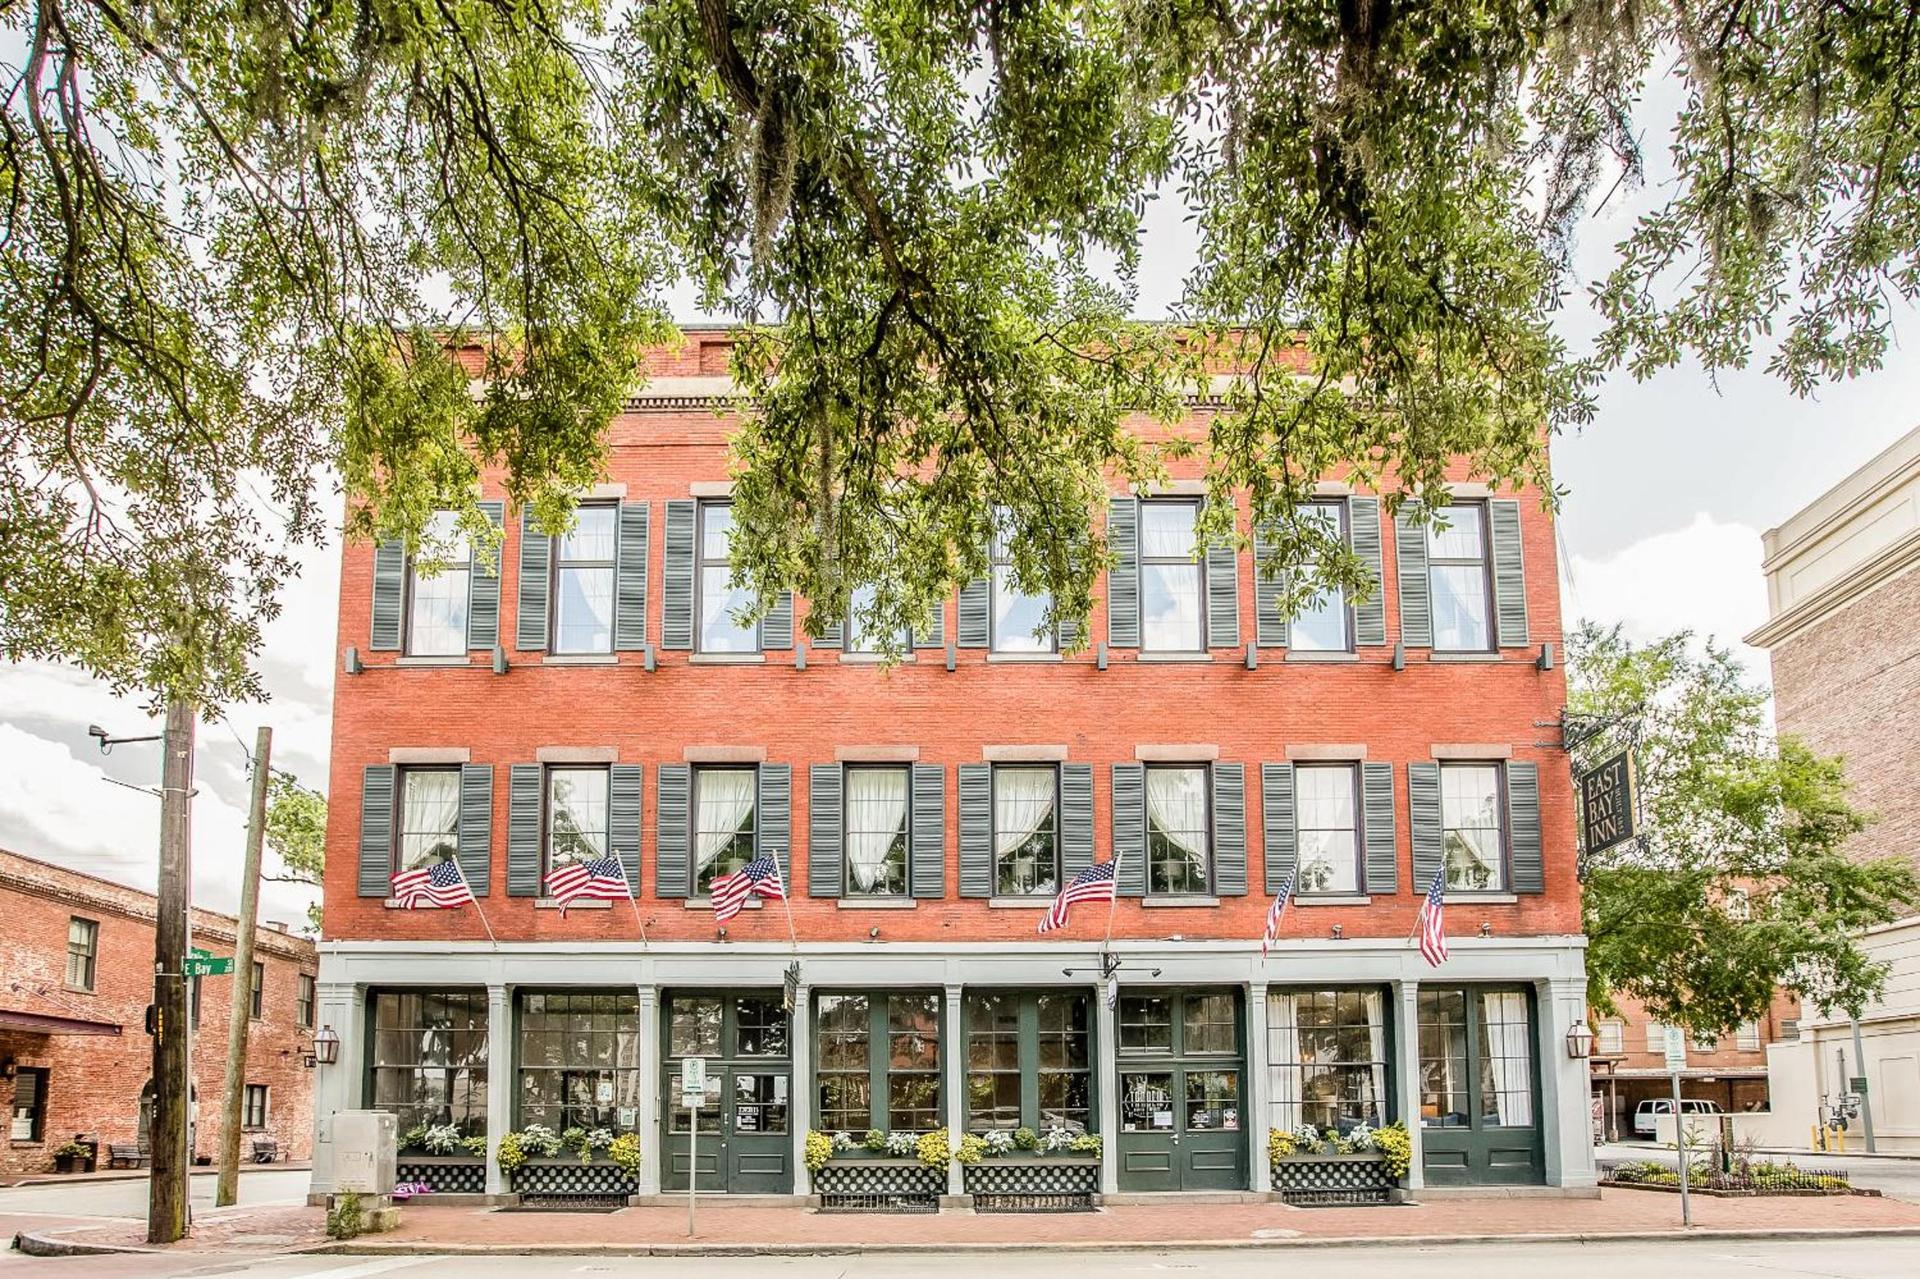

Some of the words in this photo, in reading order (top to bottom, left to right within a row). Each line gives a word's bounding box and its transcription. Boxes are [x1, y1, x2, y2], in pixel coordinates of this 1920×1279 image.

[1587, 761, 1622, 801] EAST
[1589, 790, 1615, 824] BAY
[1590, 815, 1618, 848] INN
[184, 963, 191, 976] E
[195, 962, 212, 976] Bay
